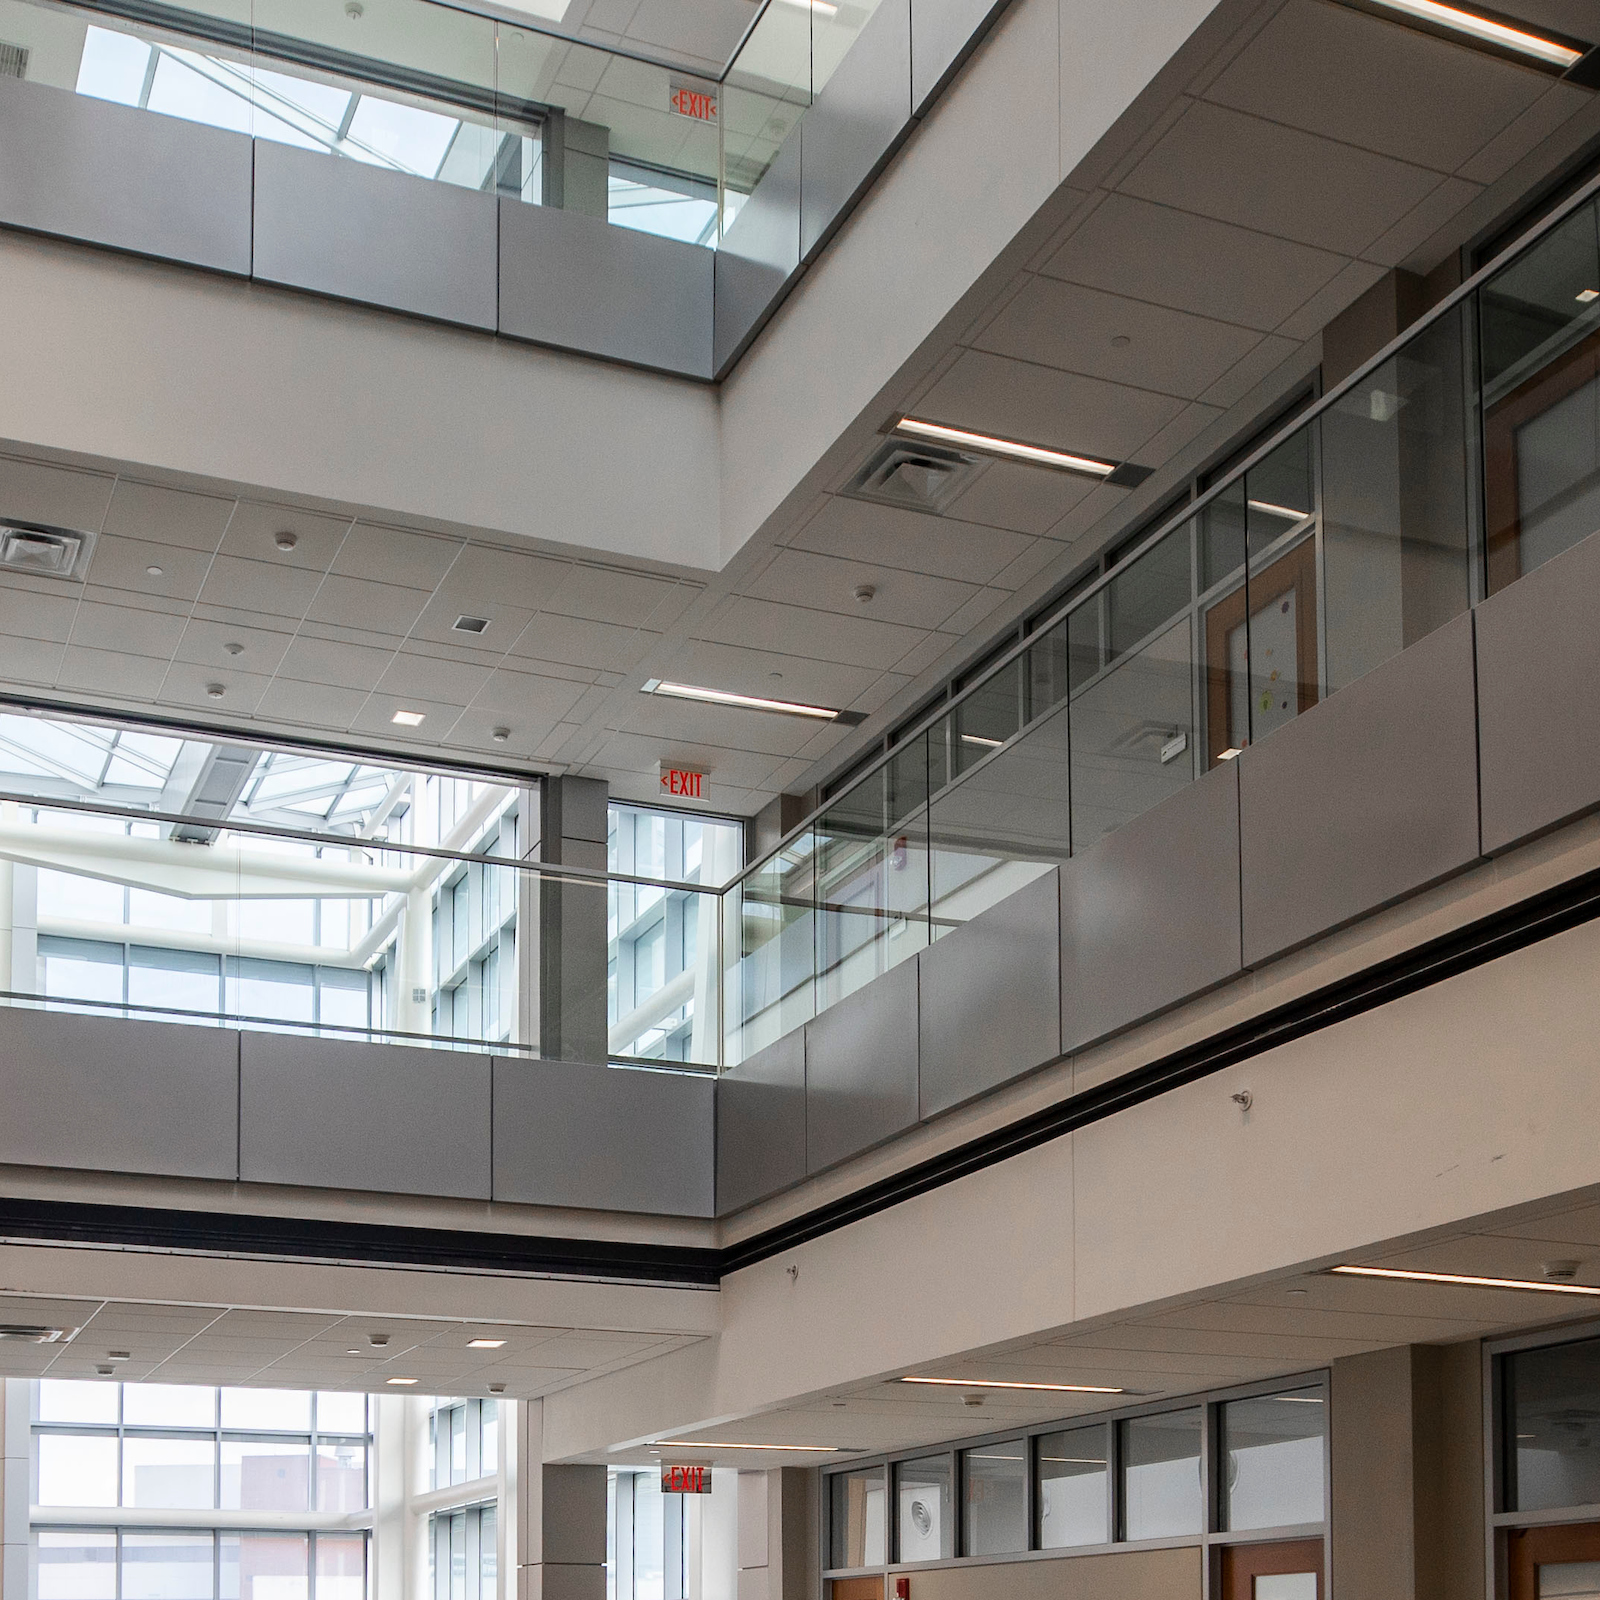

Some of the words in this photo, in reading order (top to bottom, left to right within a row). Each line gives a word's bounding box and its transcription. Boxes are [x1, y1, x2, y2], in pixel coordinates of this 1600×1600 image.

[679, 89, 712, 120] EXIT
[669, 769, 702, 797] EXIT
[670, 1466, 704, 1491] EXIT
